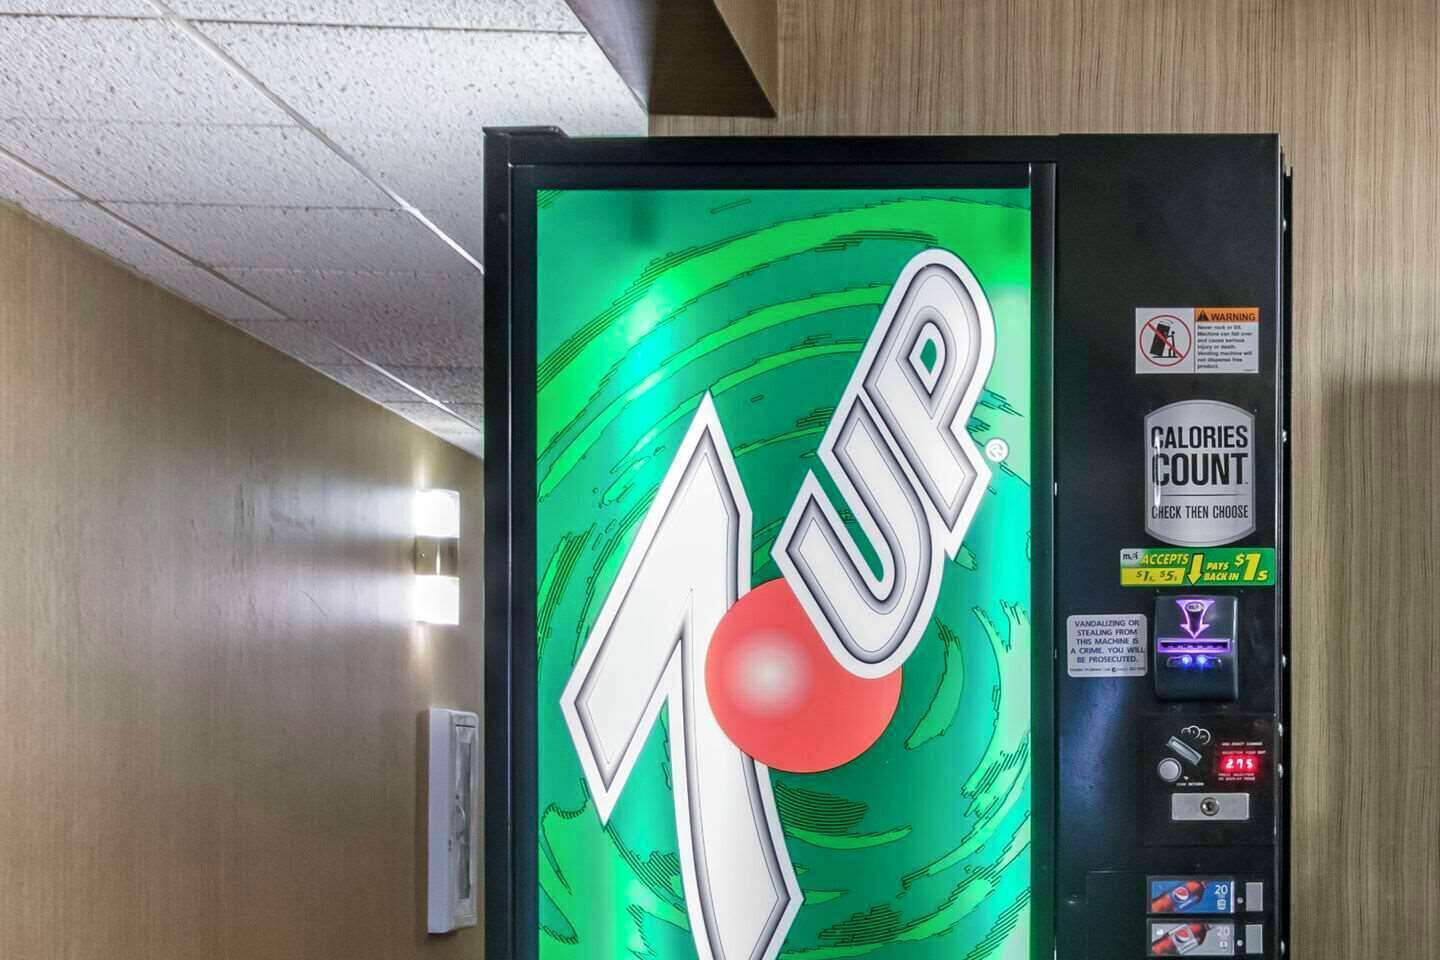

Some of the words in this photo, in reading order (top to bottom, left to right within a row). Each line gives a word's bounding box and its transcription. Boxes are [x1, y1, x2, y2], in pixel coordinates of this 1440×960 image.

[1210, 312, 1257, 321] WARNING
[1151, 425, 1249, 449] CALORIES
[1152, 453, 1249, 486] COUNT
[1151, 505, 1182, 519] CHECK
[1185, 505, 1209, 519] THEN
[1212, 504, 1249, 519] CHOOSE
[1141, 553, 1190, 565] ACCEPTS
[1206, 562, 1230, 571] PAYS
[1204, 573, 1228, 581] BACK
[1214, 885, 1228, 895] 20
[1216, 926, 1231, 937] 20
